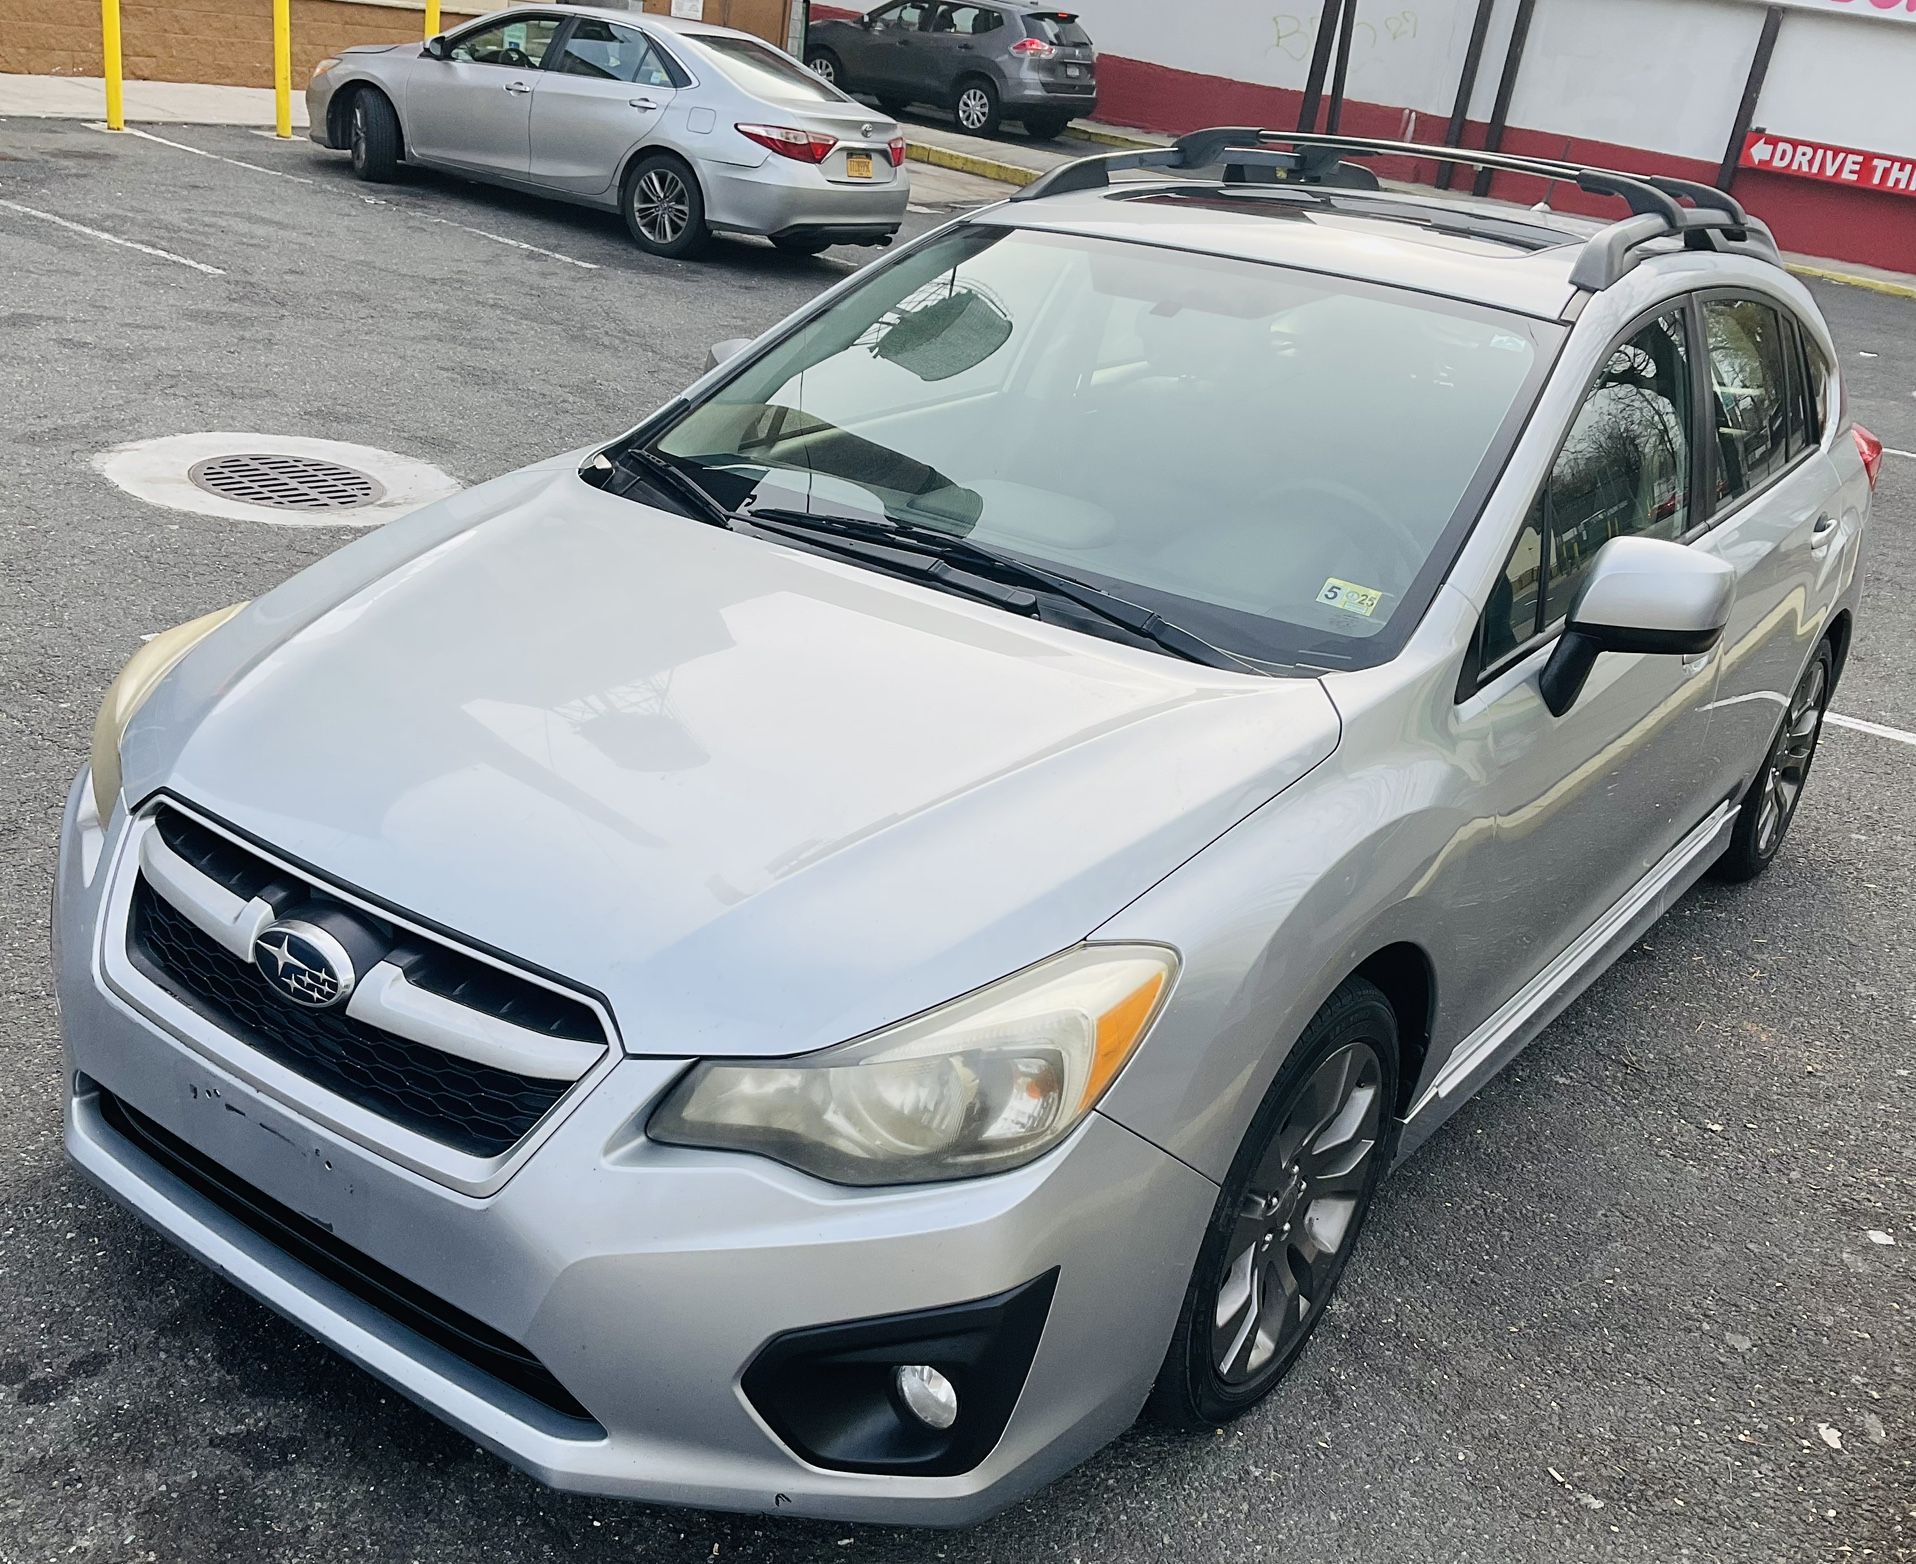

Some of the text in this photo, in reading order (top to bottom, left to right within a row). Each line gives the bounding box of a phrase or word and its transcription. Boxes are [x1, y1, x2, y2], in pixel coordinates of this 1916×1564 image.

[1772, 142, 1916, 191] DRIVE TH
[1324, 586, 1377, 607] 5 25
